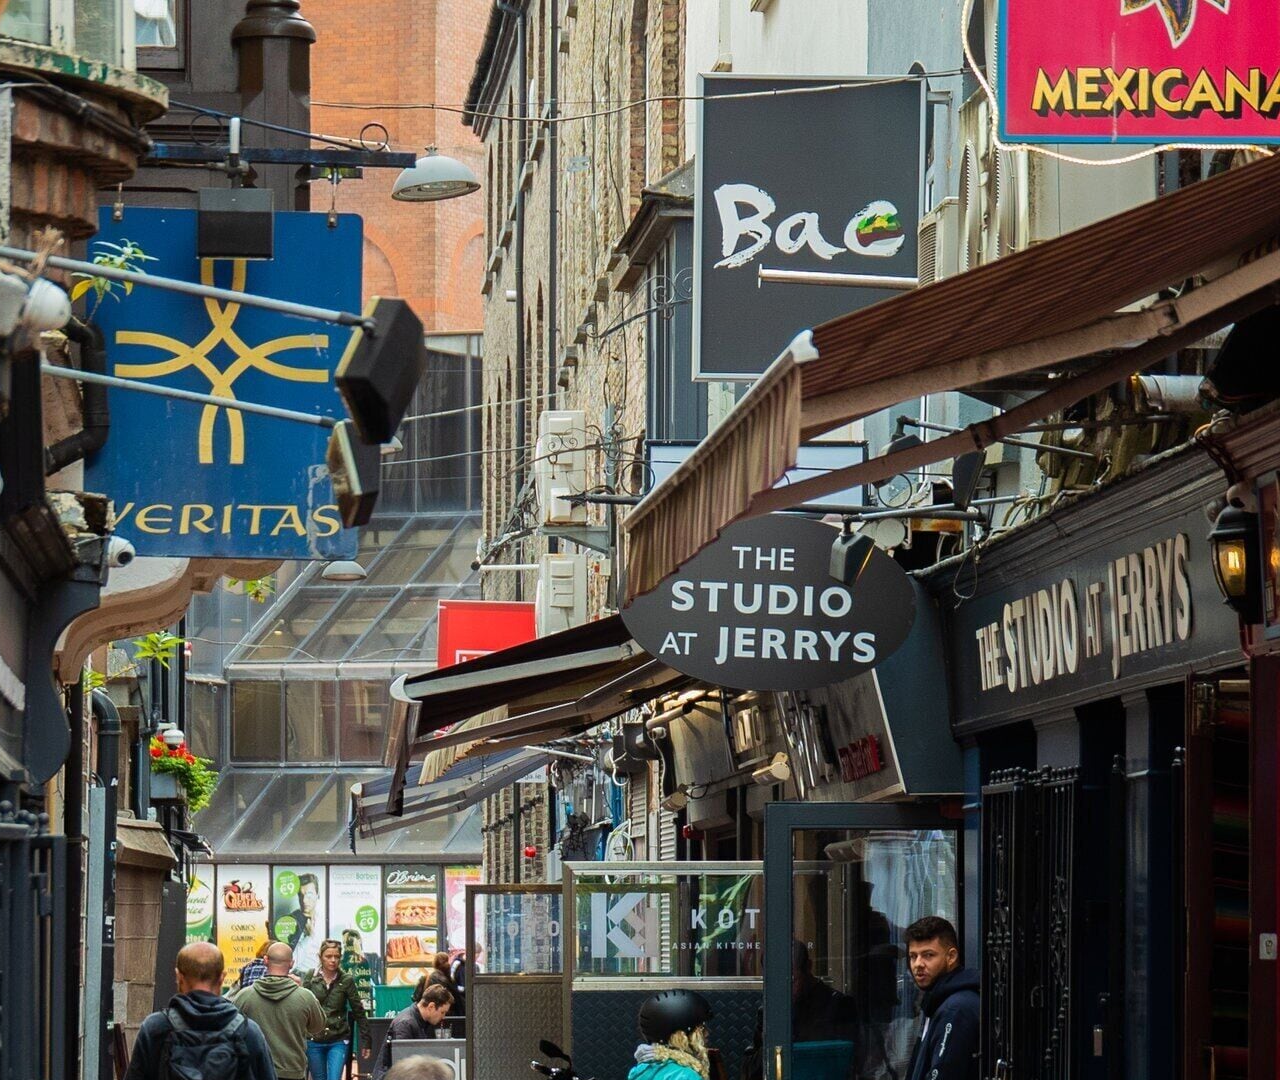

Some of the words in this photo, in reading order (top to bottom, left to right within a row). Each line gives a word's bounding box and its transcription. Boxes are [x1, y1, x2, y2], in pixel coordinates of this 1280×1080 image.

[713, 182, 906, 270] Bac
[731, 545, 797, 573] THE
[670, 580, 853, 618] STUDIO
[975, 623, 1006, 692] THE
[1002, 577, 1079, 692] STUDIO
[1083, 581, 1104, 660] AT
[1106, 531, 1193, 681] JERRYS
[658, 630, 700, 656] AT
[713, 625, 877, 667] JERRYS
[690, 908, 761, 930] KOT
[672, 941, 710, 950] ASIAN
[716, 941, 761, 950] KITCHE
